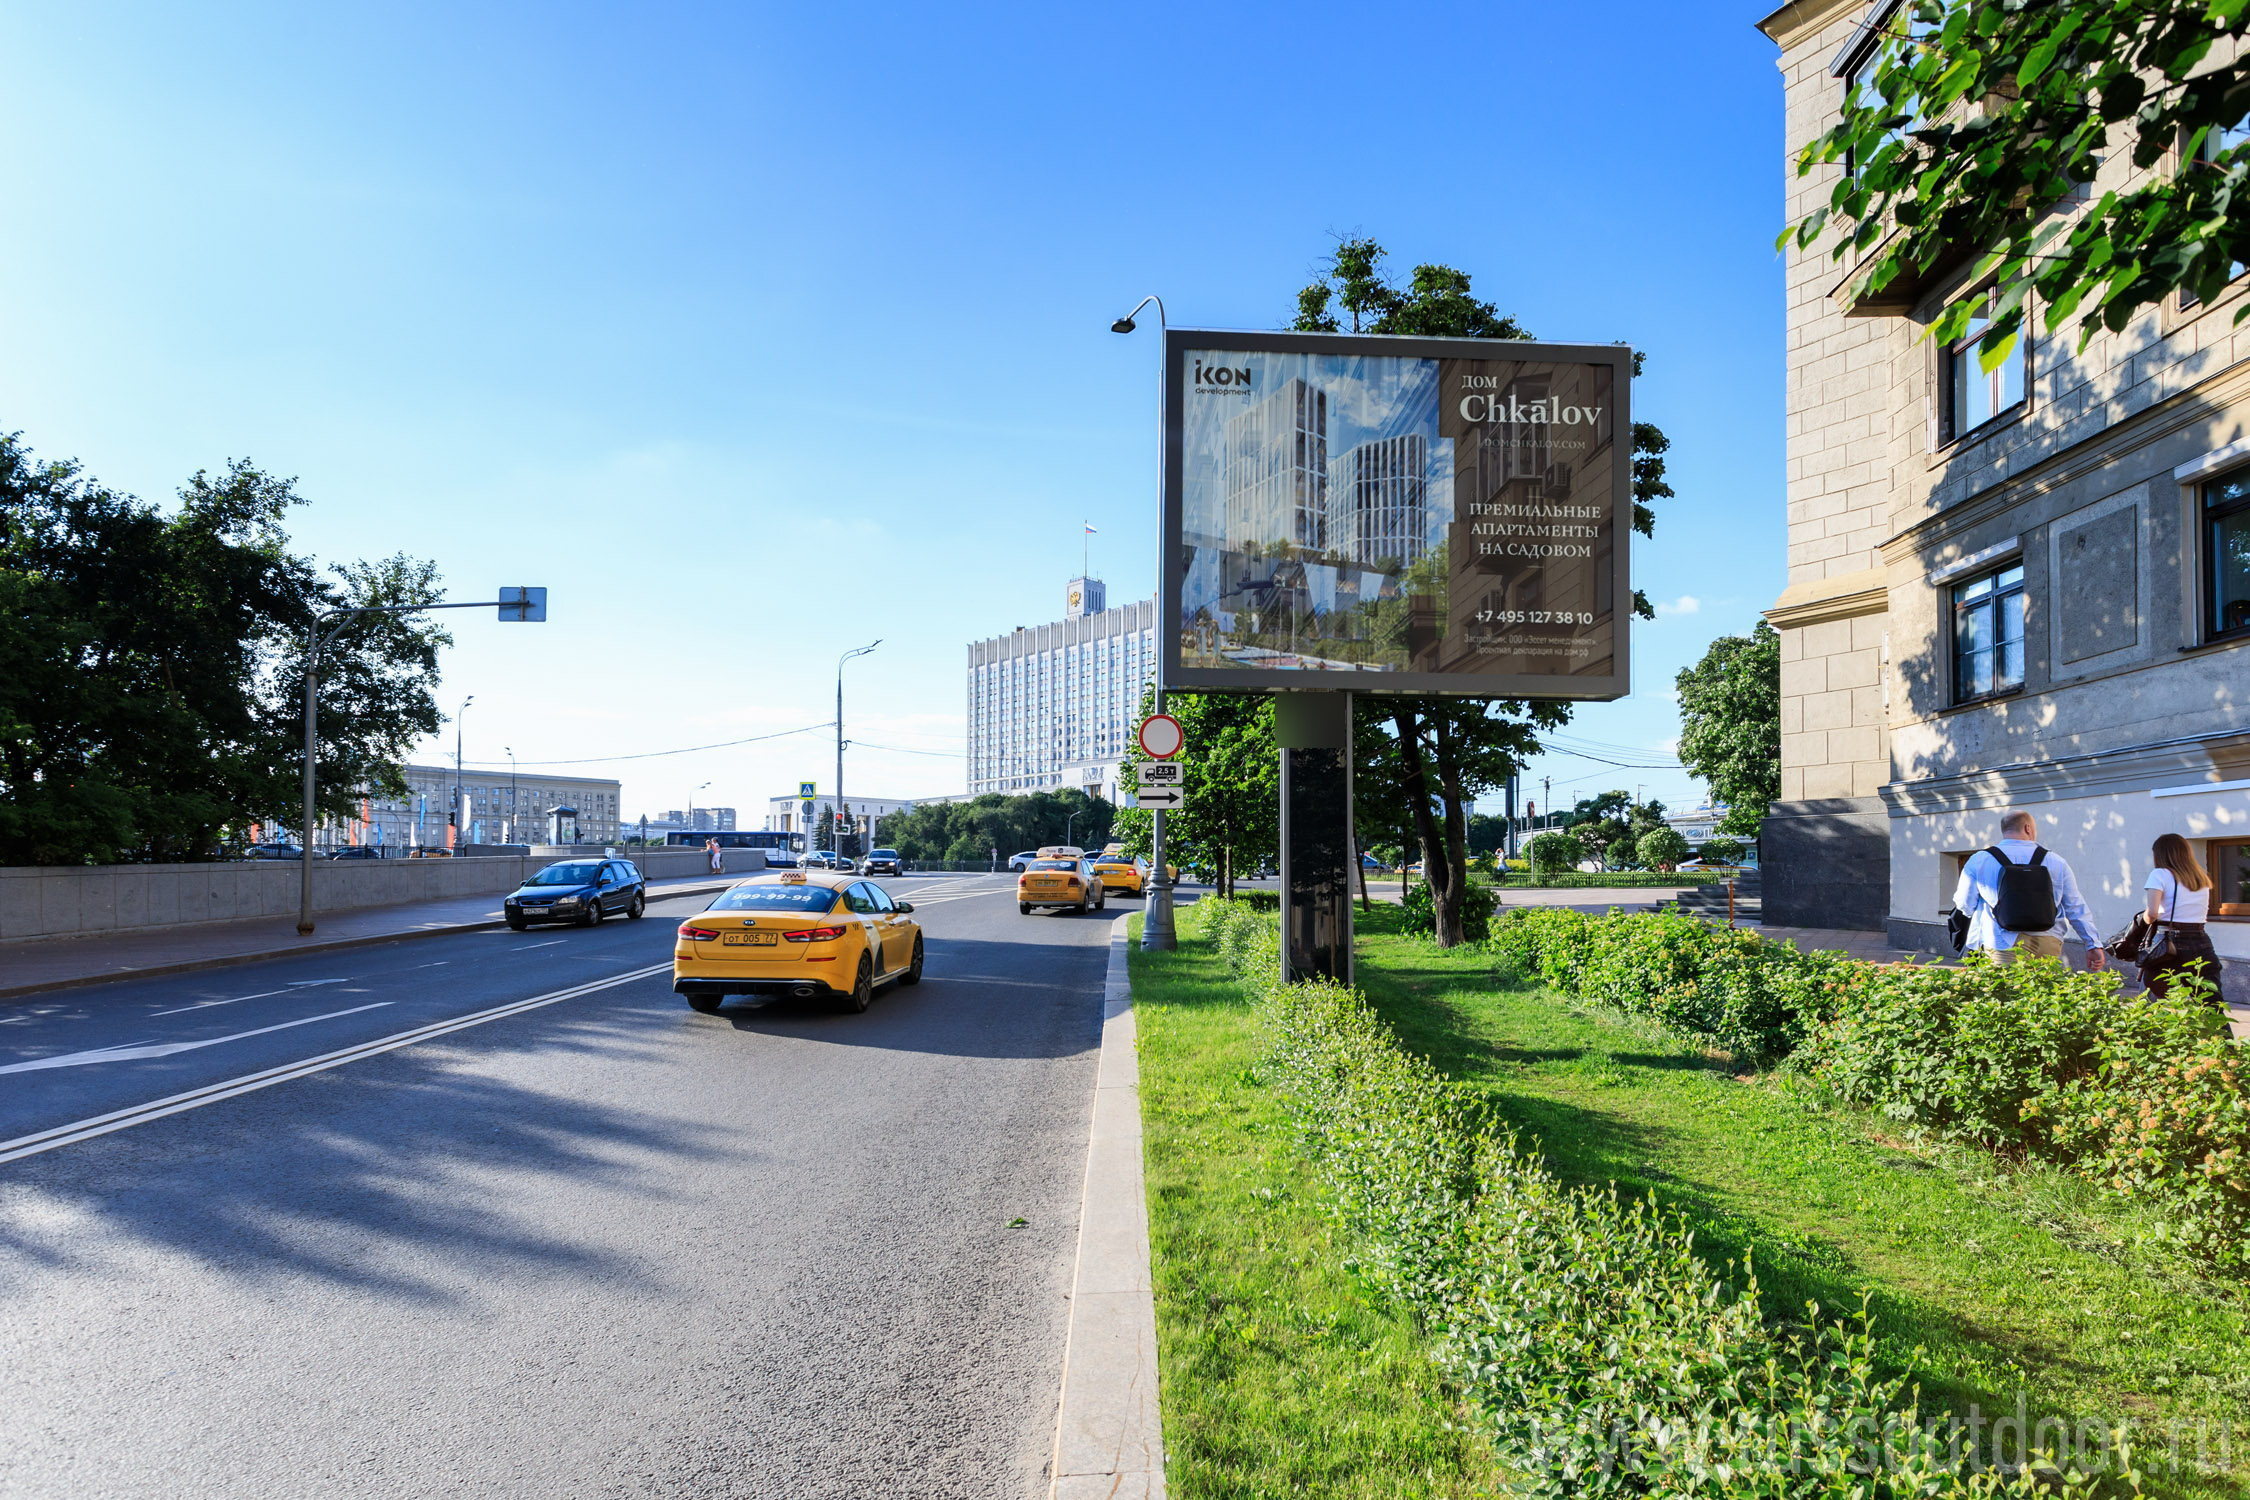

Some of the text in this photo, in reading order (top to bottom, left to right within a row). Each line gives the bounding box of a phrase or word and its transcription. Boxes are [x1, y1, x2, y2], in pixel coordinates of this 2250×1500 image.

[1461, 375, 1498, 389] ДОМ
[1469, 503, 1601, 519] ПРЕМИАЛЬНЫЕ
[1470, 523, 1599, 538] АПАРТАМЕНТЫ
[1479, 543, 1591, 559] НА САДОВОМ
[1475, 610, 1593, 625] +7 495 127 38 10
[743, 934, 760, 943] 005
